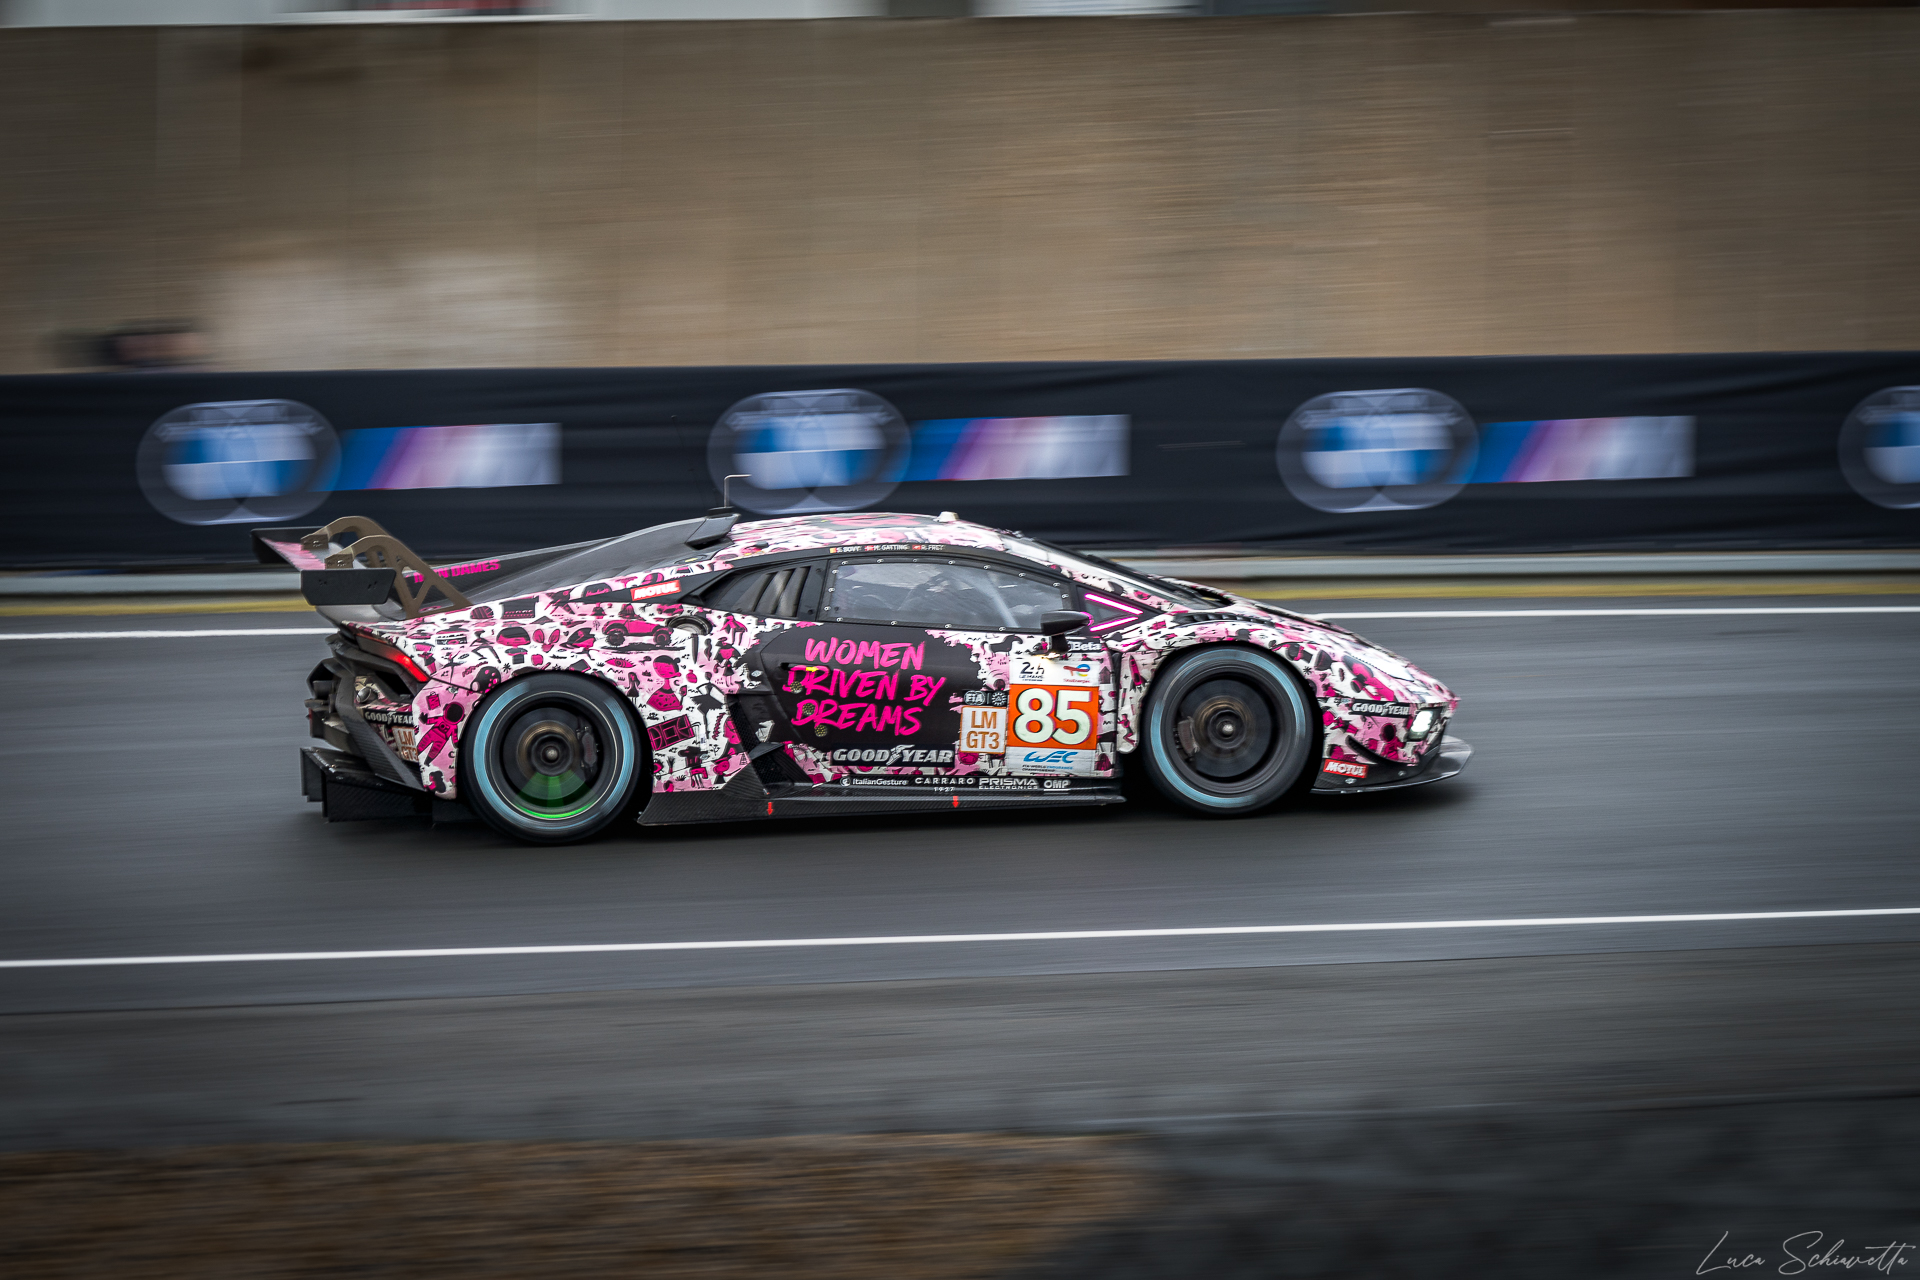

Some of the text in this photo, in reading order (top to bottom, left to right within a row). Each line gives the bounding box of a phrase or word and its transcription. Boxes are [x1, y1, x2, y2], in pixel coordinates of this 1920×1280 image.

[450, 559, 501, 577] DAMES
[633, 581, 680, 599] MOTUL
[805, 637, 925, 670] WOMEN
[1072, 641, 1101, 651] Beta
[782, 665, 900, 700] DRIVEN
[903, 674, 947, 706] BY
[791, 699, 924, 736] DREAMS
[971, 710, 997, 729] LM
[1014, 688, 1092, 745] 85
[398, 730, 414, 746] LM
[966, 731, 1000, 749] GT3
[1023, 750, 1078, 764] WEC
[1325, 761, 1367, 776] MOTUL
[978, 778, 1038, 786] PRISMA
[1044, 780, 1070, 788] OMP
